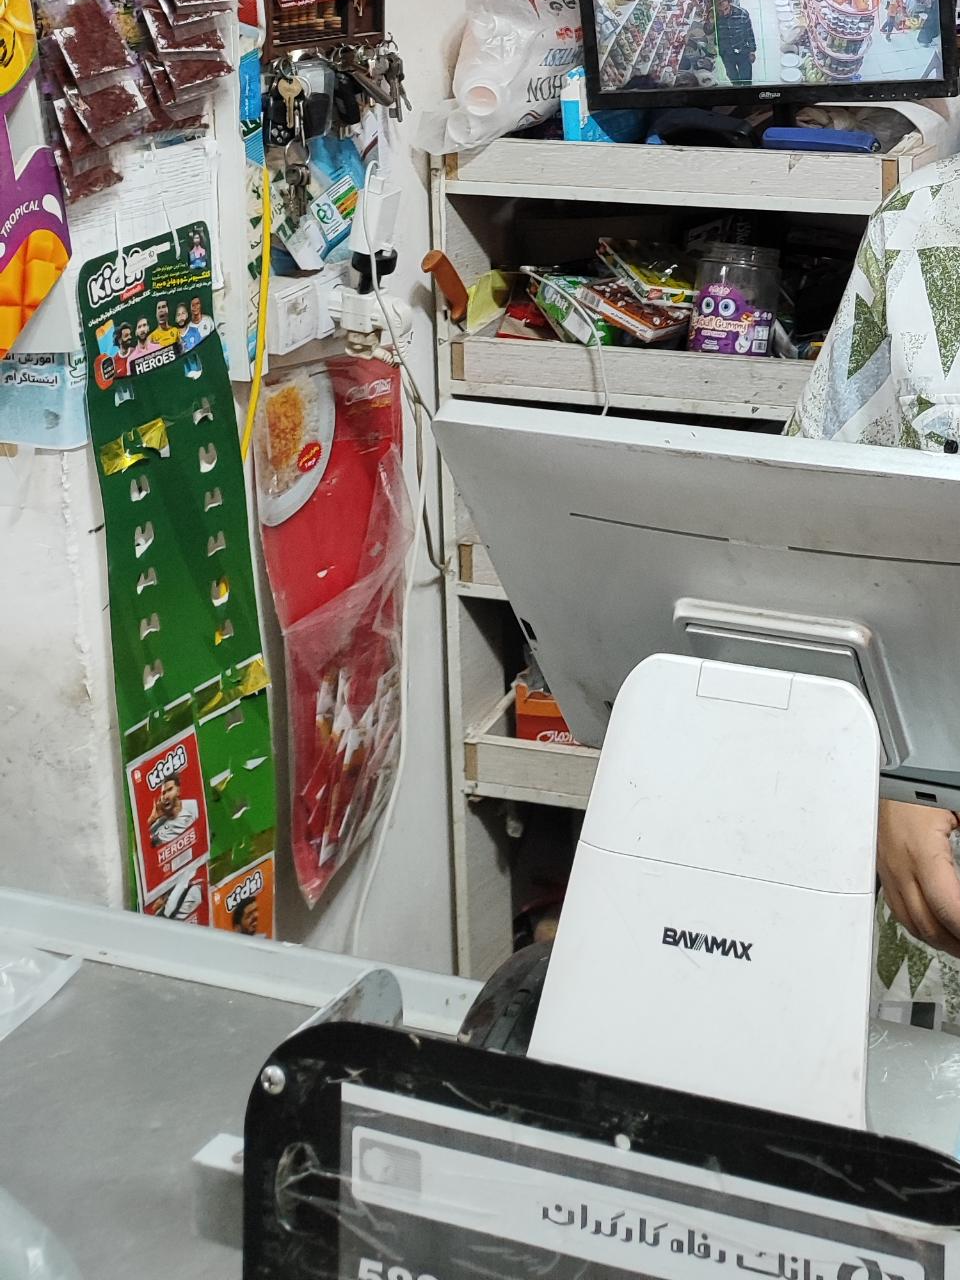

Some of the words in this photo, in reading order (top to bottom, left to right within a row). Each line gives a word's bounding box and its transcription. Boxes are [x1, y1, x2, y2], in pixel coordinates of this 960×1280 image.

[0, 199, 41, 240] TROPICAL
[714, 319, 748, 335] Gummy
[135, 350, 177, 375] HEROES
[148, 746, 186, 791] Kidsi
[159, 831, 197, 863] HEROES
[226, 872, 263, 913] Kidsi
[540, 1202, 671, 1249] کارکنان
[669, 1228, 729, 1263] رفاه
